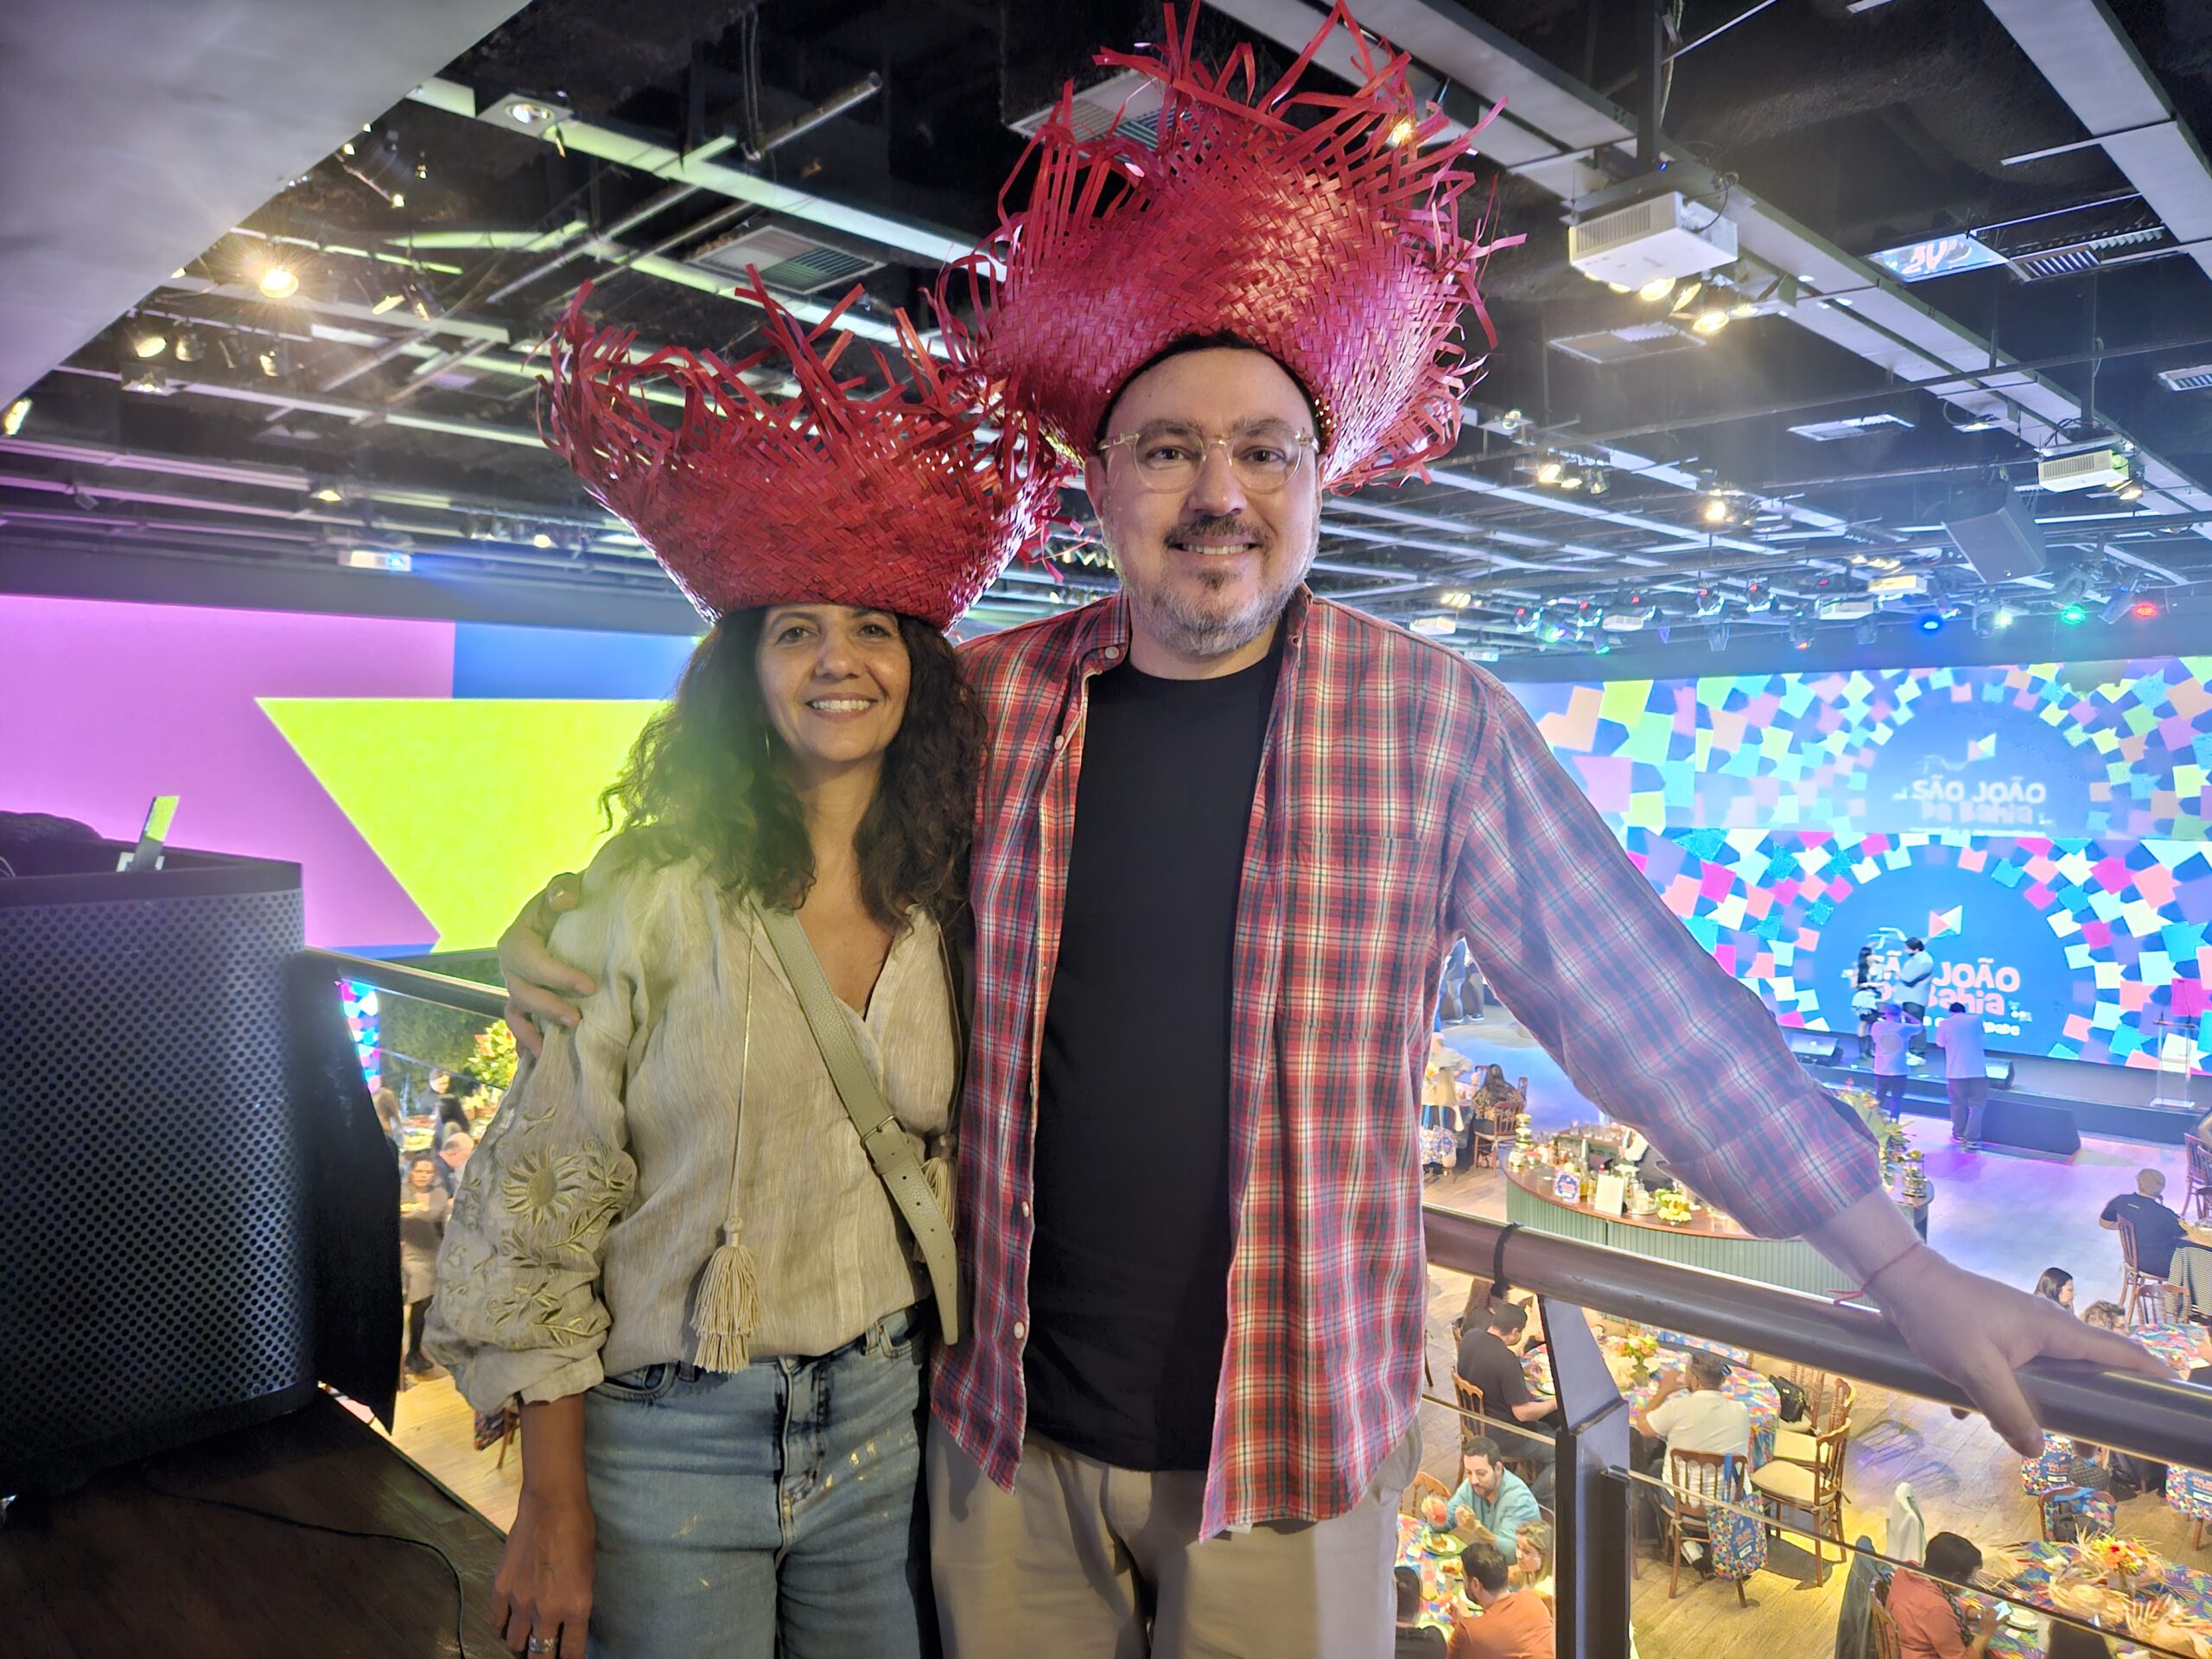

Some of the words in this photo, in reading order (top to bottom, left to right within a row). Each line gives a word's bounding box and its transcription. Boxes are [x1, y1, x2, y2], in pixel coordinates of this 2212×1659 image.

[1912, 774, 1965, 803] SÃO
[1972, 775, 2046, 804] JOÃO
[1932, 957, 2020, 993] JOÃO
